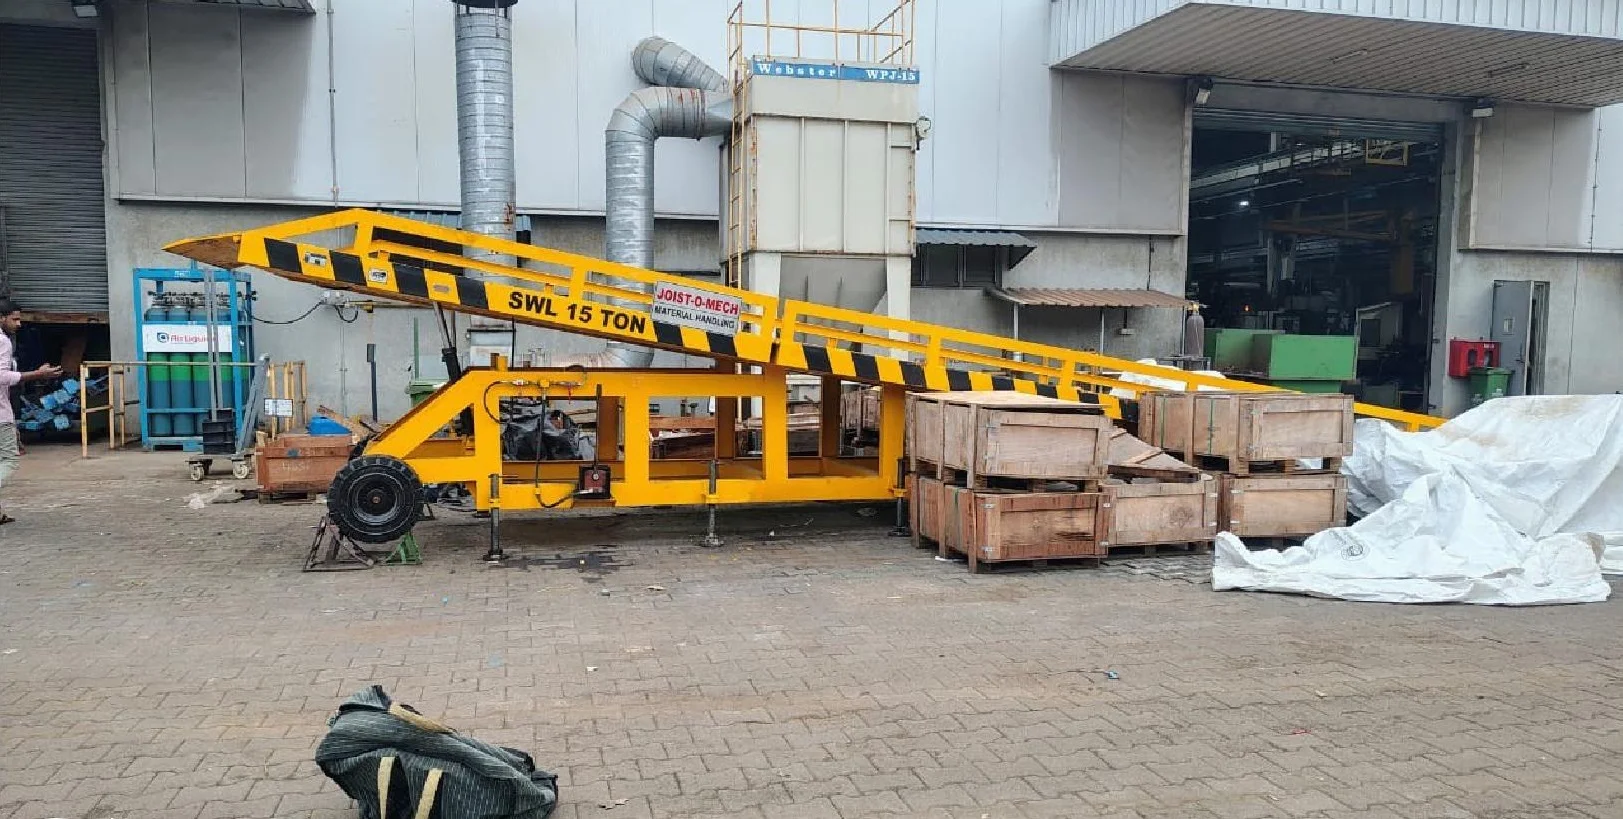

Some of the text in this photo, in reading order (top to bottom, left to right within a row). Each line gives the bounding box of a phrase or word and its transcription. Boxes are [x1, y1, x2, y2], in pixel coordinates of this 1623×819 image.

[757, 63, 916, 81] Webster WPJ-15
[508, 291, 646, 334] SWL 15 TON
[657, 288, 739, 315] JOIST-O-MECH
[654, 305, 735, 329] MATERIAL HANDLING
